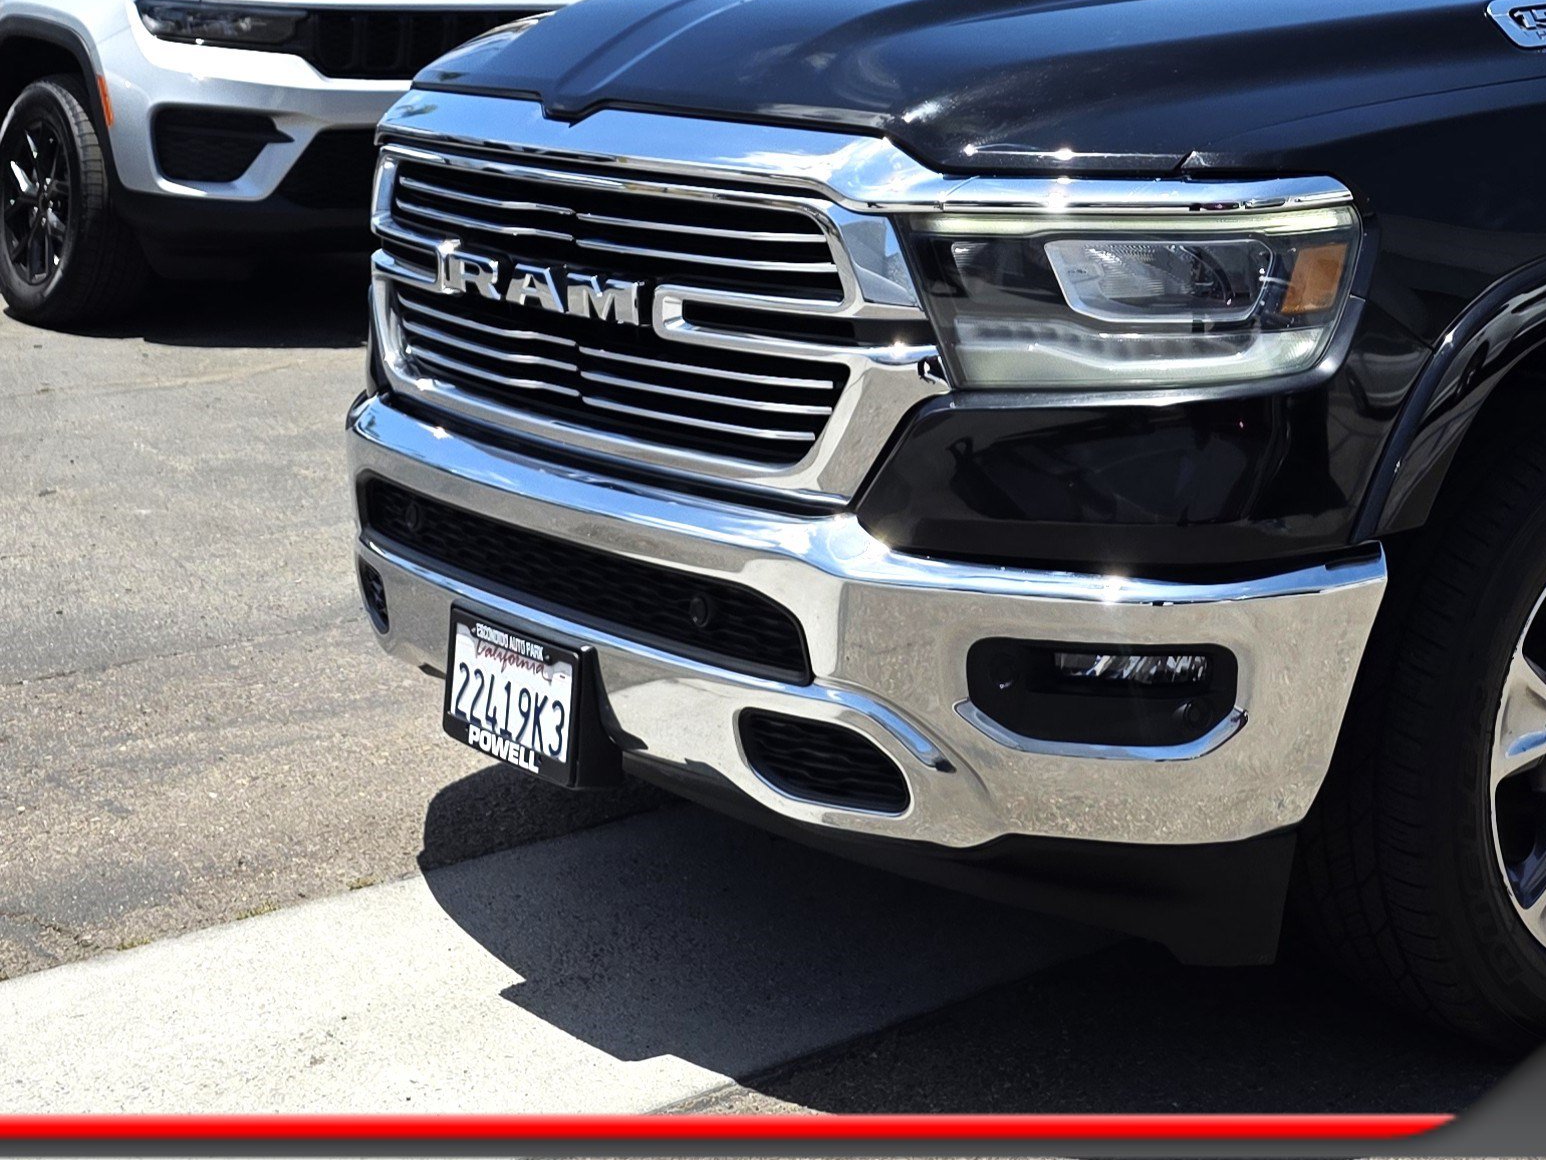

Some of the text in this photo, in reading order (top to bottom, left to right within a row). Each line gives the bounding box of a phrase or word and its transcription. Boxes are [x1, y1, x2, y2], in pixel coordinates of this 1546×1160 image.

[447, 250, 643, 327] RAM
[509, 635, 527, 655] AUTO
[526, 641, 545, 661] PARK
[455, 662, 566, 757] 22419K3
[468, 724, 540, 775] POWELL
